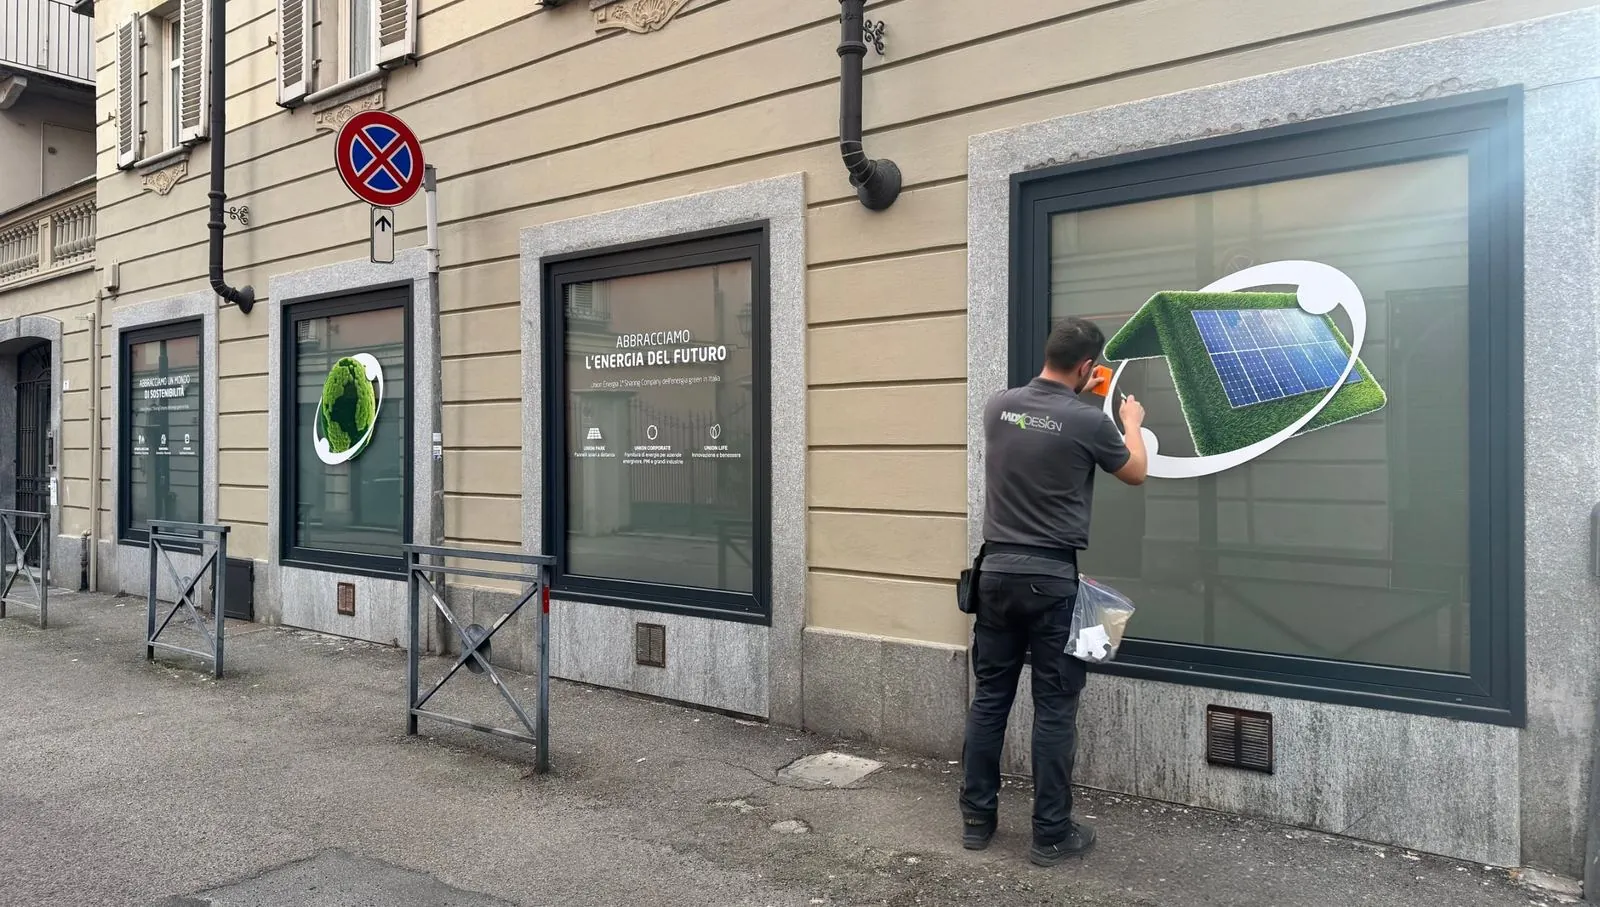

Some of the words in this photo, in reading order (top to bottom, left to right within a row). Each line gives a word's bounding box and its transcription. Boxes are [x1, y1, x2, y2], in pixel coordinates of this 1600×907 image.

[616, 329, 690, 348] ABBRACCIAMO
[585, 351, 645, 369] L'ENERGIA
[647, 350, 670, 366] DEL
[673, 345, 727, 364] FUTURO
[139, 377, 167, 388] ABBRACCIAMO
[167, 377, 174, 385] UN
[174, 374, 191, 385] MONDO
[640, 378, 661, 388] Company
[144, 389, 150, 399] DI
[150, 385, 185, 399] SOSTENIBILITÀ
